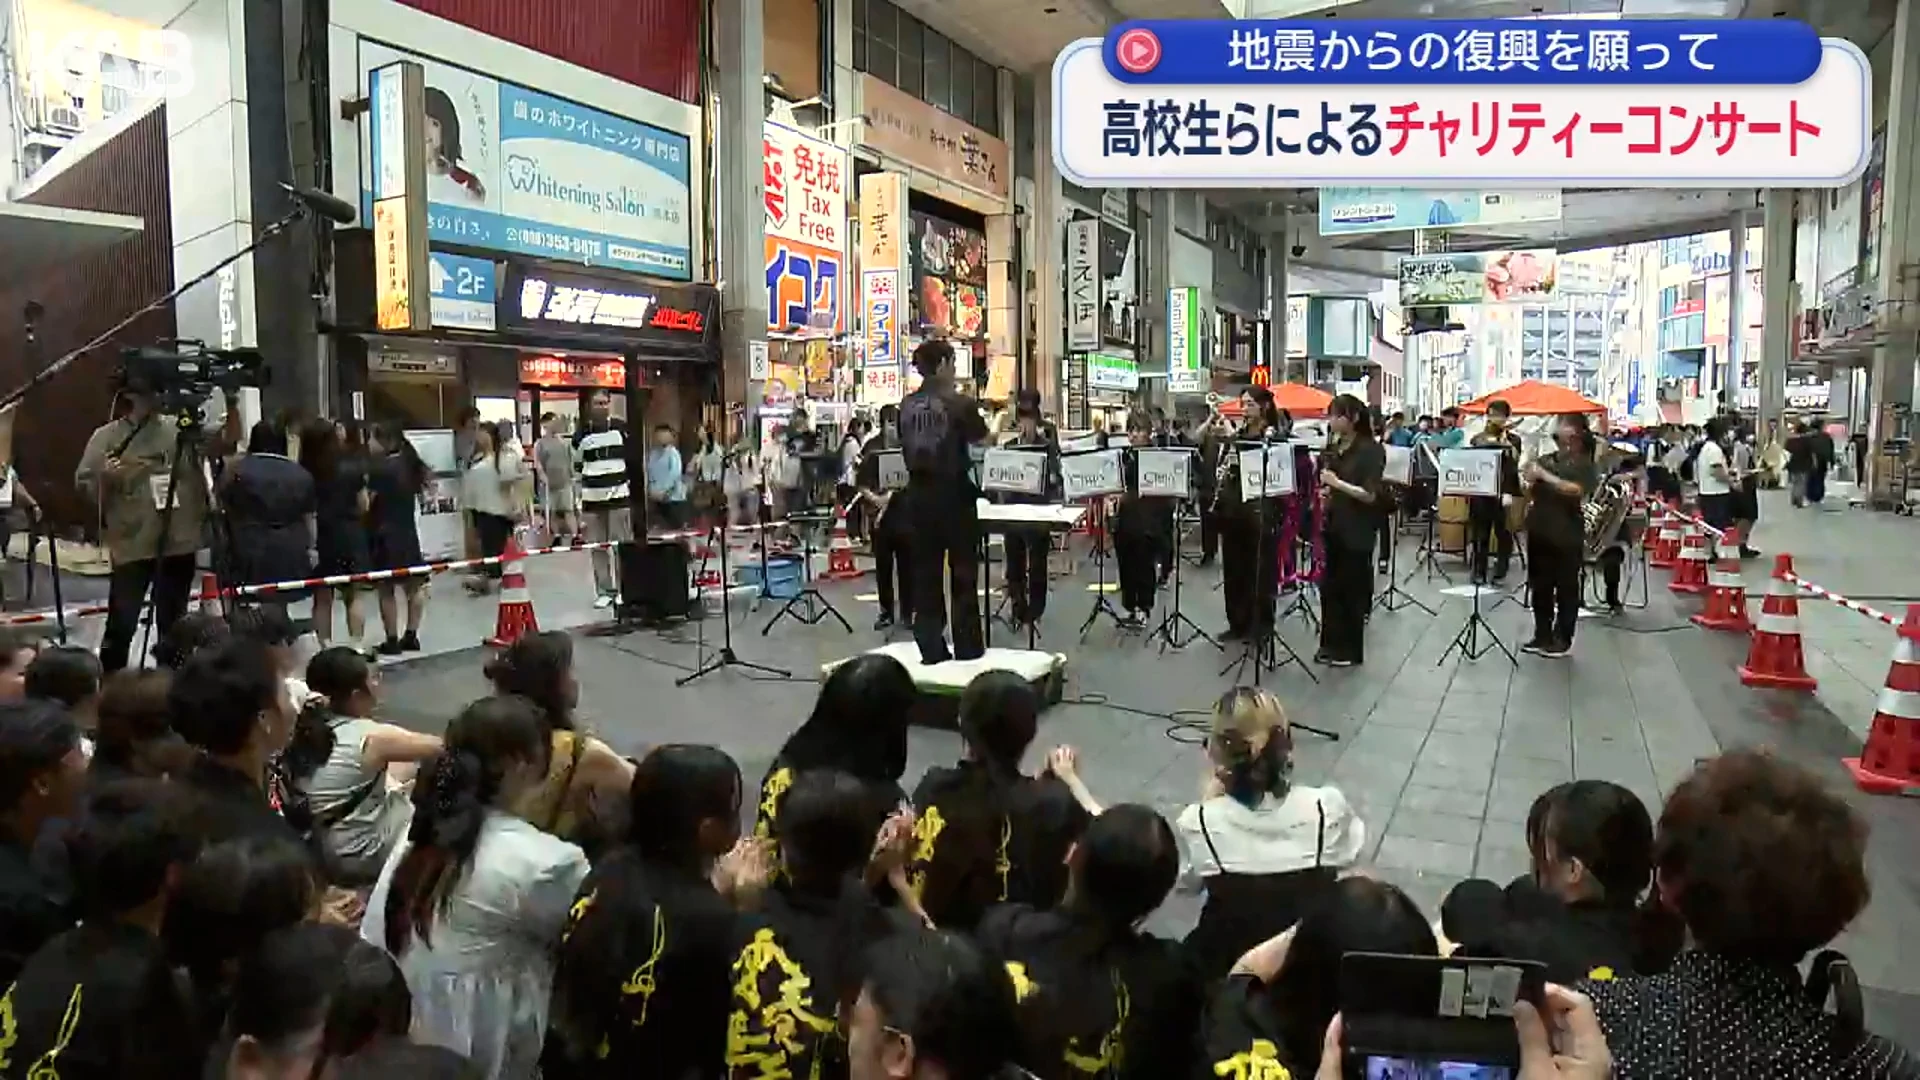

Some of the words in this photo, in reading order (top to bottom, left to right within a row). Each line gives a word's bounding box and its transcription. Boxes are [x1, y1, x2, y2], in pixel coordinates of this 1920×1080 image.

[793, 143, 840, 193] 免税
[802, 187, 831, 216] Tax
[799, 212, 835, 243] Free
[457, 266, 486, 295] 2F
[1172, 292, 1186, 368] FamilyMart
